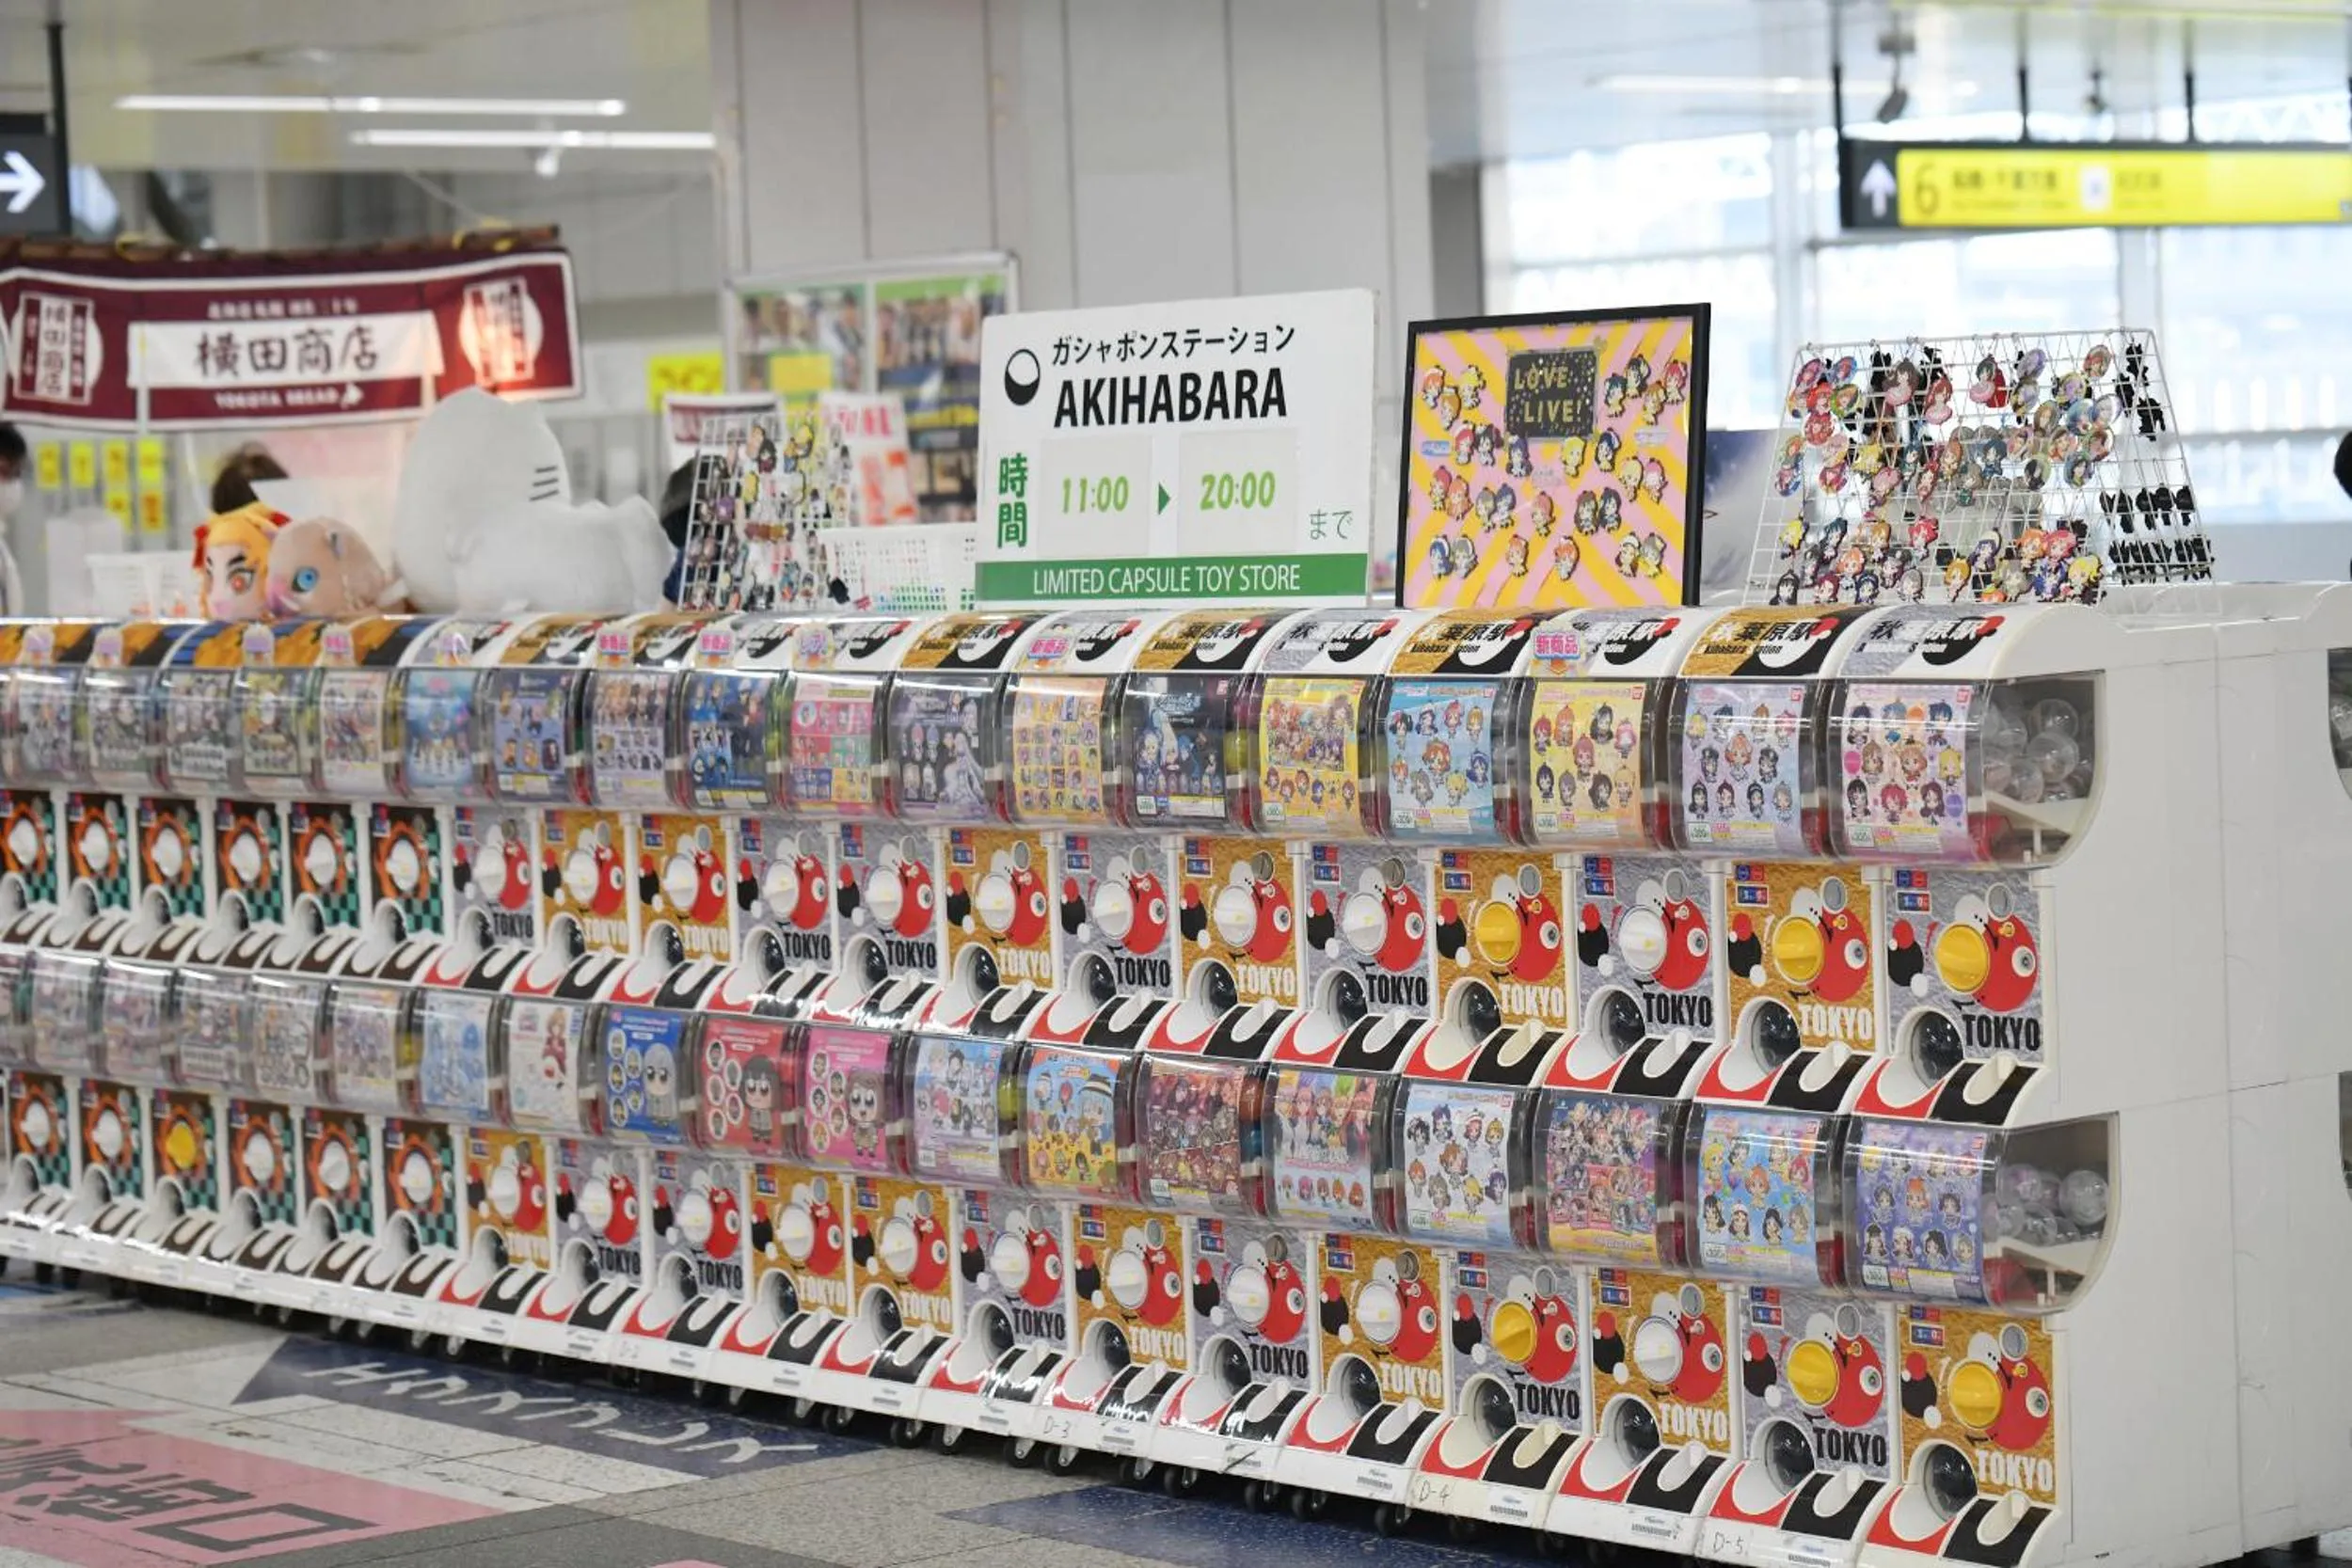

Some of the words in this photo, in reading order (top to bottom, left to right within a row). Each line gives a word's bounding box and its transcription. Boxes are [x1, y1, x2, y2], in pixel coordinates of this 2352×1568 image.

[196, 325, 378, 378] 横田商店
[1052, 324, 1295, 367] ガシャポンステーション
[1514, 364, 1569, 390] LOVE
[1053, 367, 1288, 428] AKIHABARA
[1523, 400, 1582, 424] LIVE!
[997, 452, 1028, 549] 時間
[1062, 475, 1130, 514] 11:00
[1200, 471, 1276, 511] 20:00
[1309, 509, 1353, 541] まで
[1034, 569, 1104, 595] LIMITED
[1108, 566, 1192, 594] CAPSULE
[1196, 566, 1235, 592] TOY
[1239, 564, 1301, 591] STORE
[1535, 635, 1579, 655] 新商品
[493, 911, 533, 940] TOKYO
[783, 931, 832, 960] TOKYO
[886, 940, 936, 970] TOKYO
[998, 947, 1052, 978] TOKYO
[1115, 958, 1170, 988] TOKYO
[1235, 963, 1296, 997] TOKYO
[1366, 973, 1428, 1006] TOKYO
[1499, 983, 1565, 1018] TOKYO
[1644, 992, 1713, 1027] TOKYO
[1798, 1004, 1875, 1040] TOKYO
[1963, 1014, 2042, 1051] TOKYO
[597, 1246, 641, 1275] TOKYO
[697, 1260, 743, 1290] TOKYO
[899, 1291, 951, 1324] TOKYO
[1011, 1307, 1065, 1341] TOKYO
[1129, 1325, 1184, 1360] TOKYO
[1249, 1342, 1309, 1379] TOKYO
[1379, 1361, 1442, 1400] TOKYO
[1514, 1382, 1581, 1420] TOKYO
[1043, 1419, 1073, 1439] D-3
[1657, 1403, 1730, 1442] TOKYO
[1813, 1426, 1887, 1467] TOKYO
[1973, 1449, 2054, 1494] TOKYO
[1417, 1481, 1451, 1503] D-4
[1711, 1532, 1744, 1555] D-5
